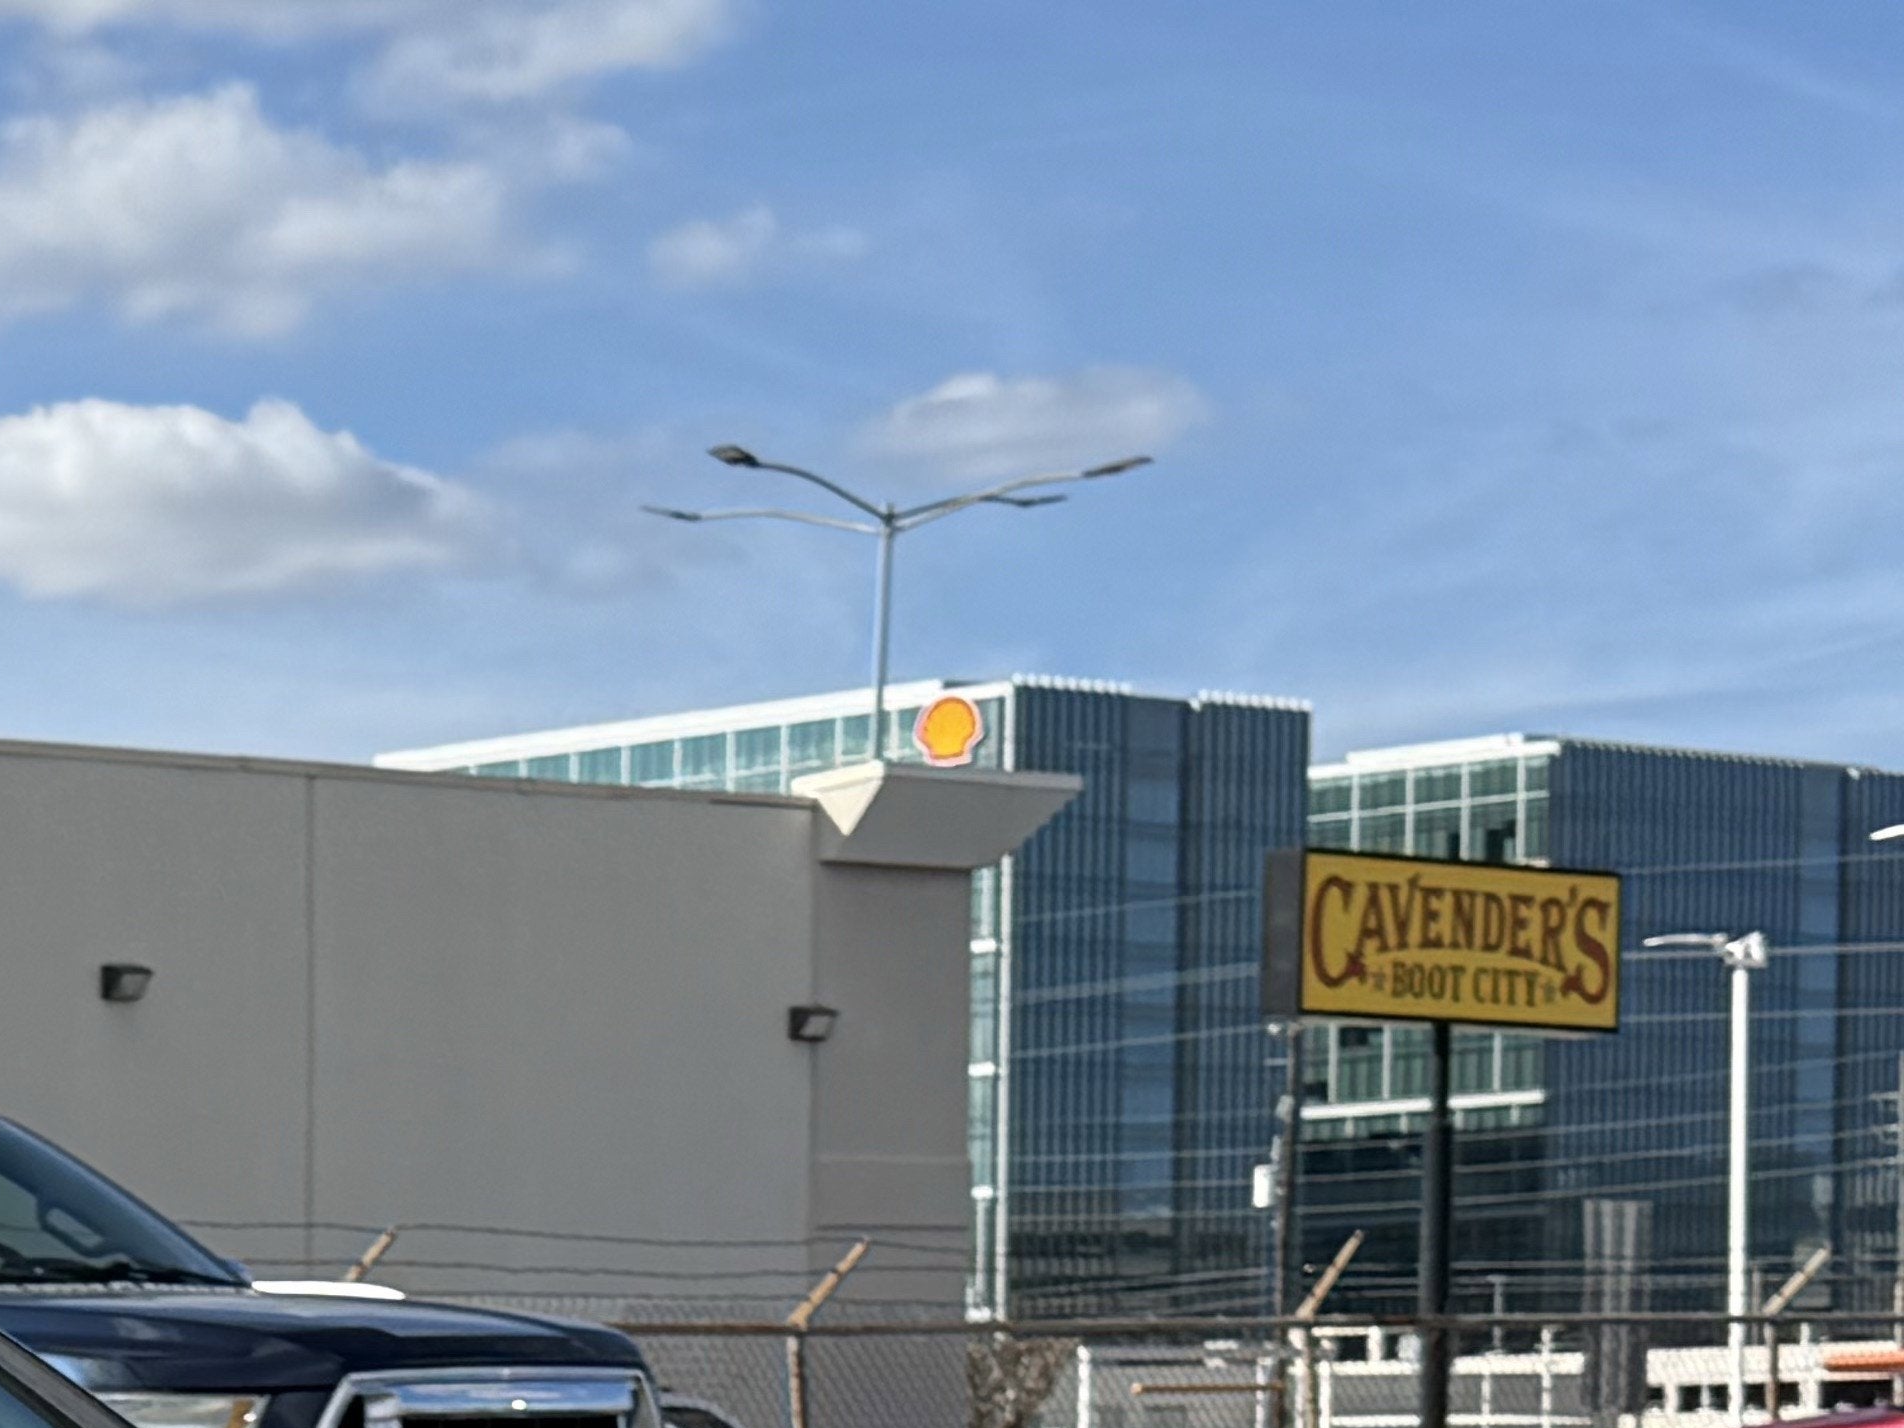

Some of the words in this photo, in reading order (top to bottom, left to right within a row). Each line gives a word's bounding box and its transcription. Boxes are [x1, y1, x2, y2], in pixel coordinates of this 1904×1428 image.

[1310, 873, 1611, 1005] CAVENDER'S
[1393, 962, 1465, 1001] BOOT
[1473, 967, 1540, 1007] CITY
